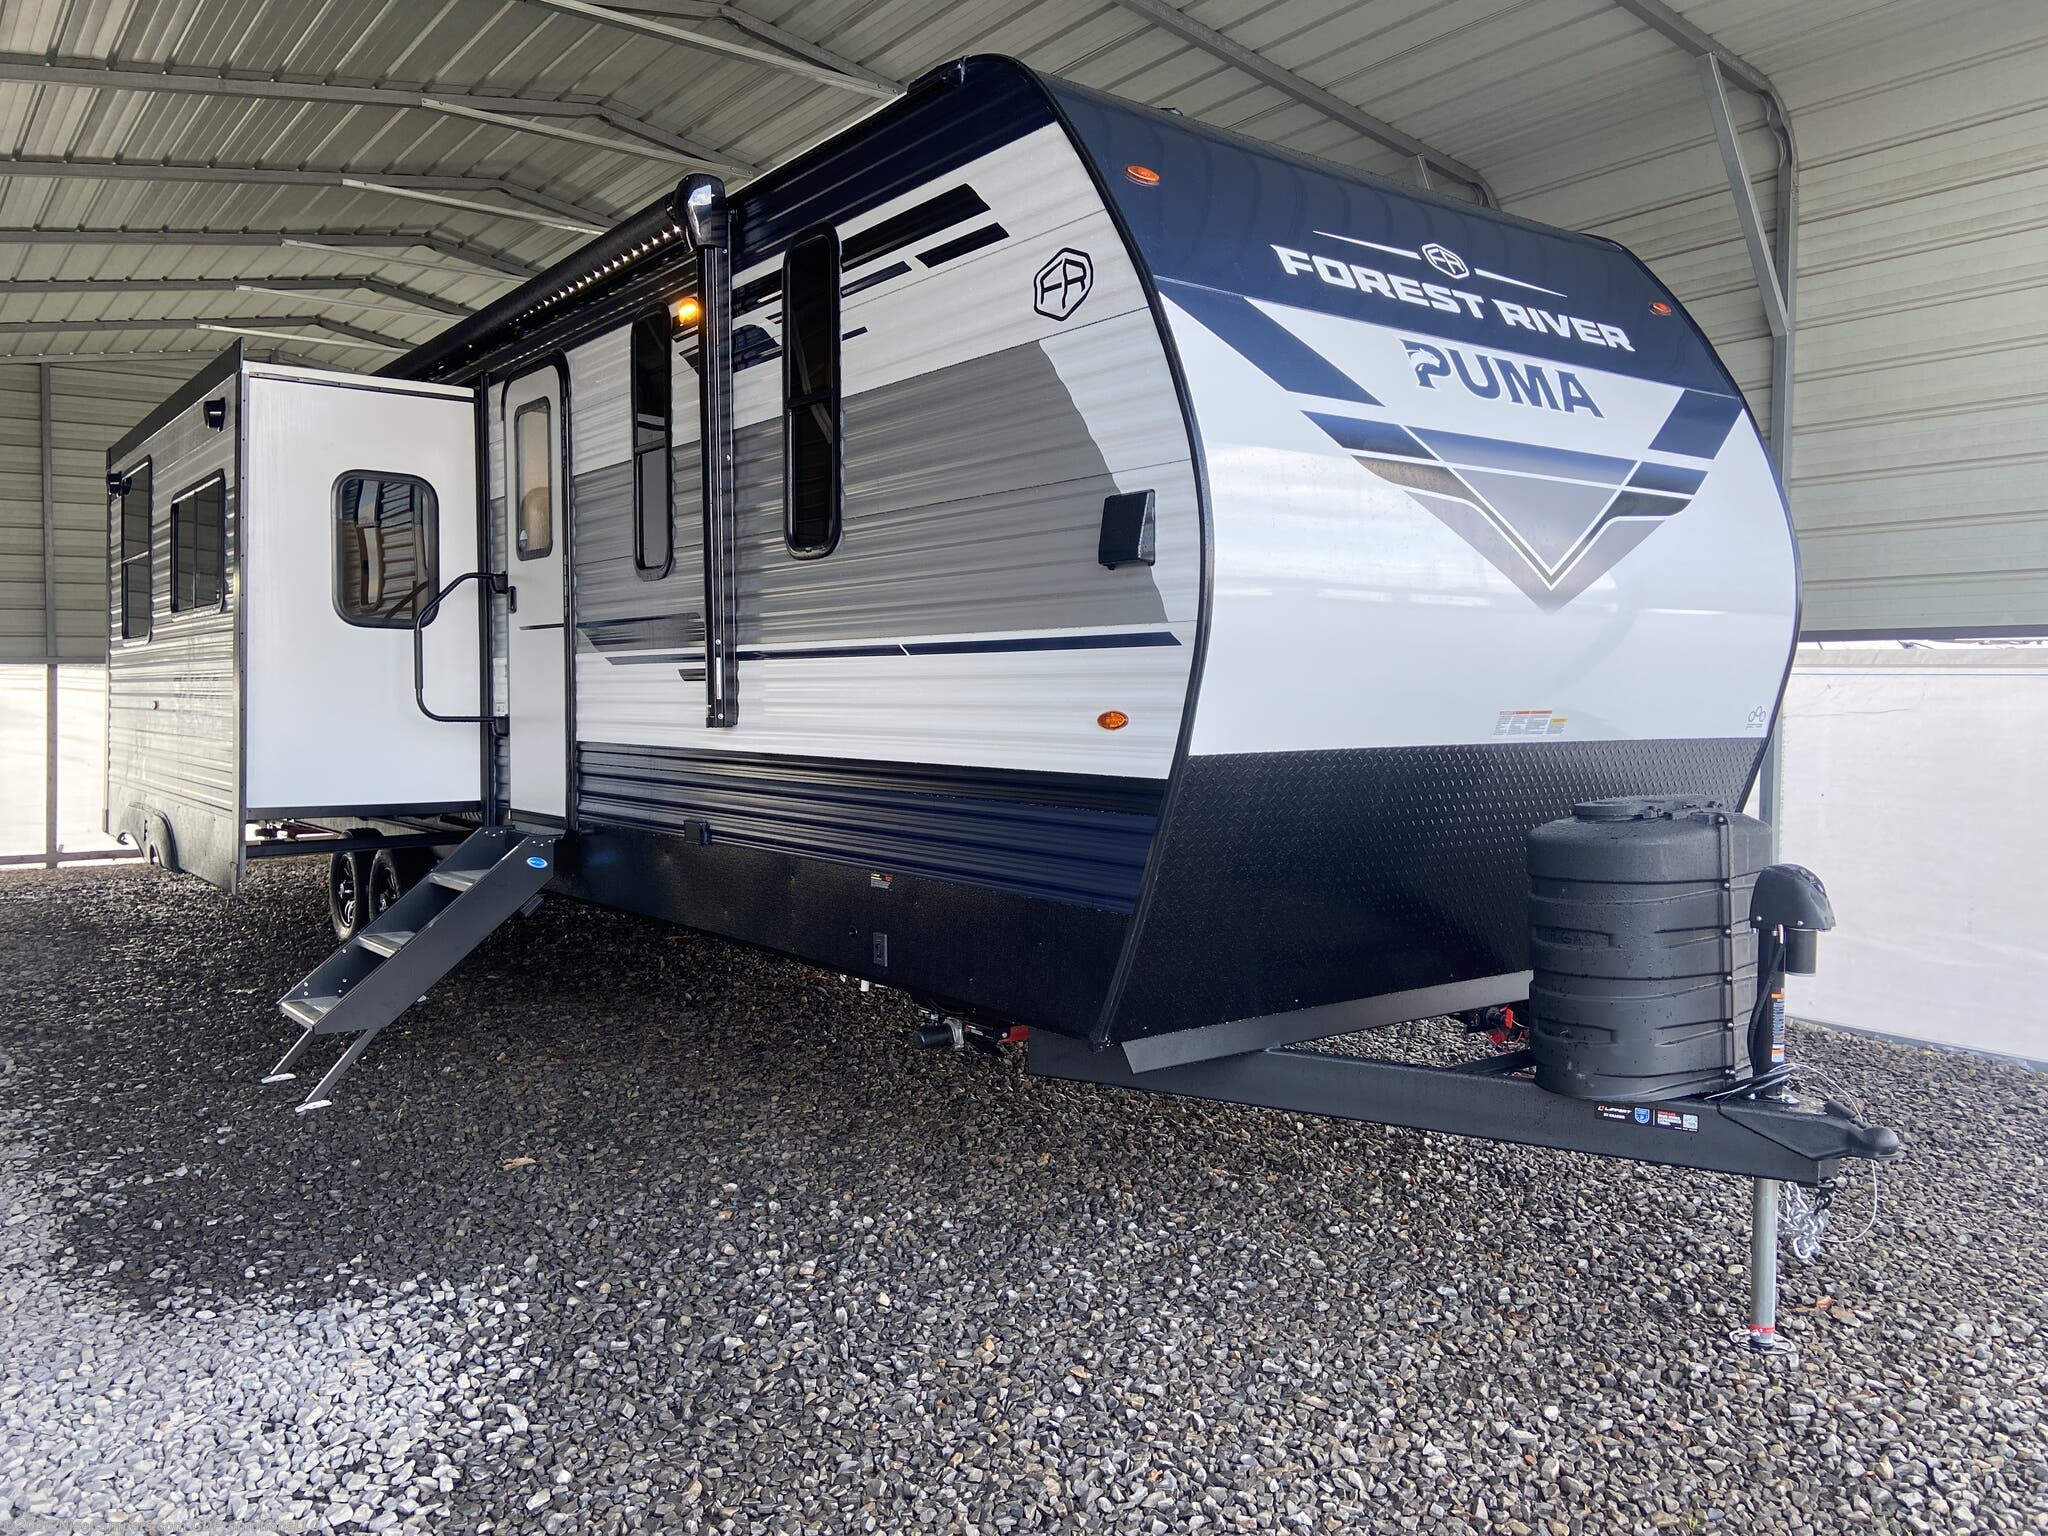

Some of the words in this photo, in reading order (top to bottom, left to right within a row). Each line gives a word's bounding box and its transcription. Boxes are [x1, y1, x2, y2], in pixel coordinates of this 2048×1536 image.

[1270, 244, 1484, 319] FOREST
[1491, 298, 1636, 352] RIVER
[1400, 338, 1605, 419] PUMA
